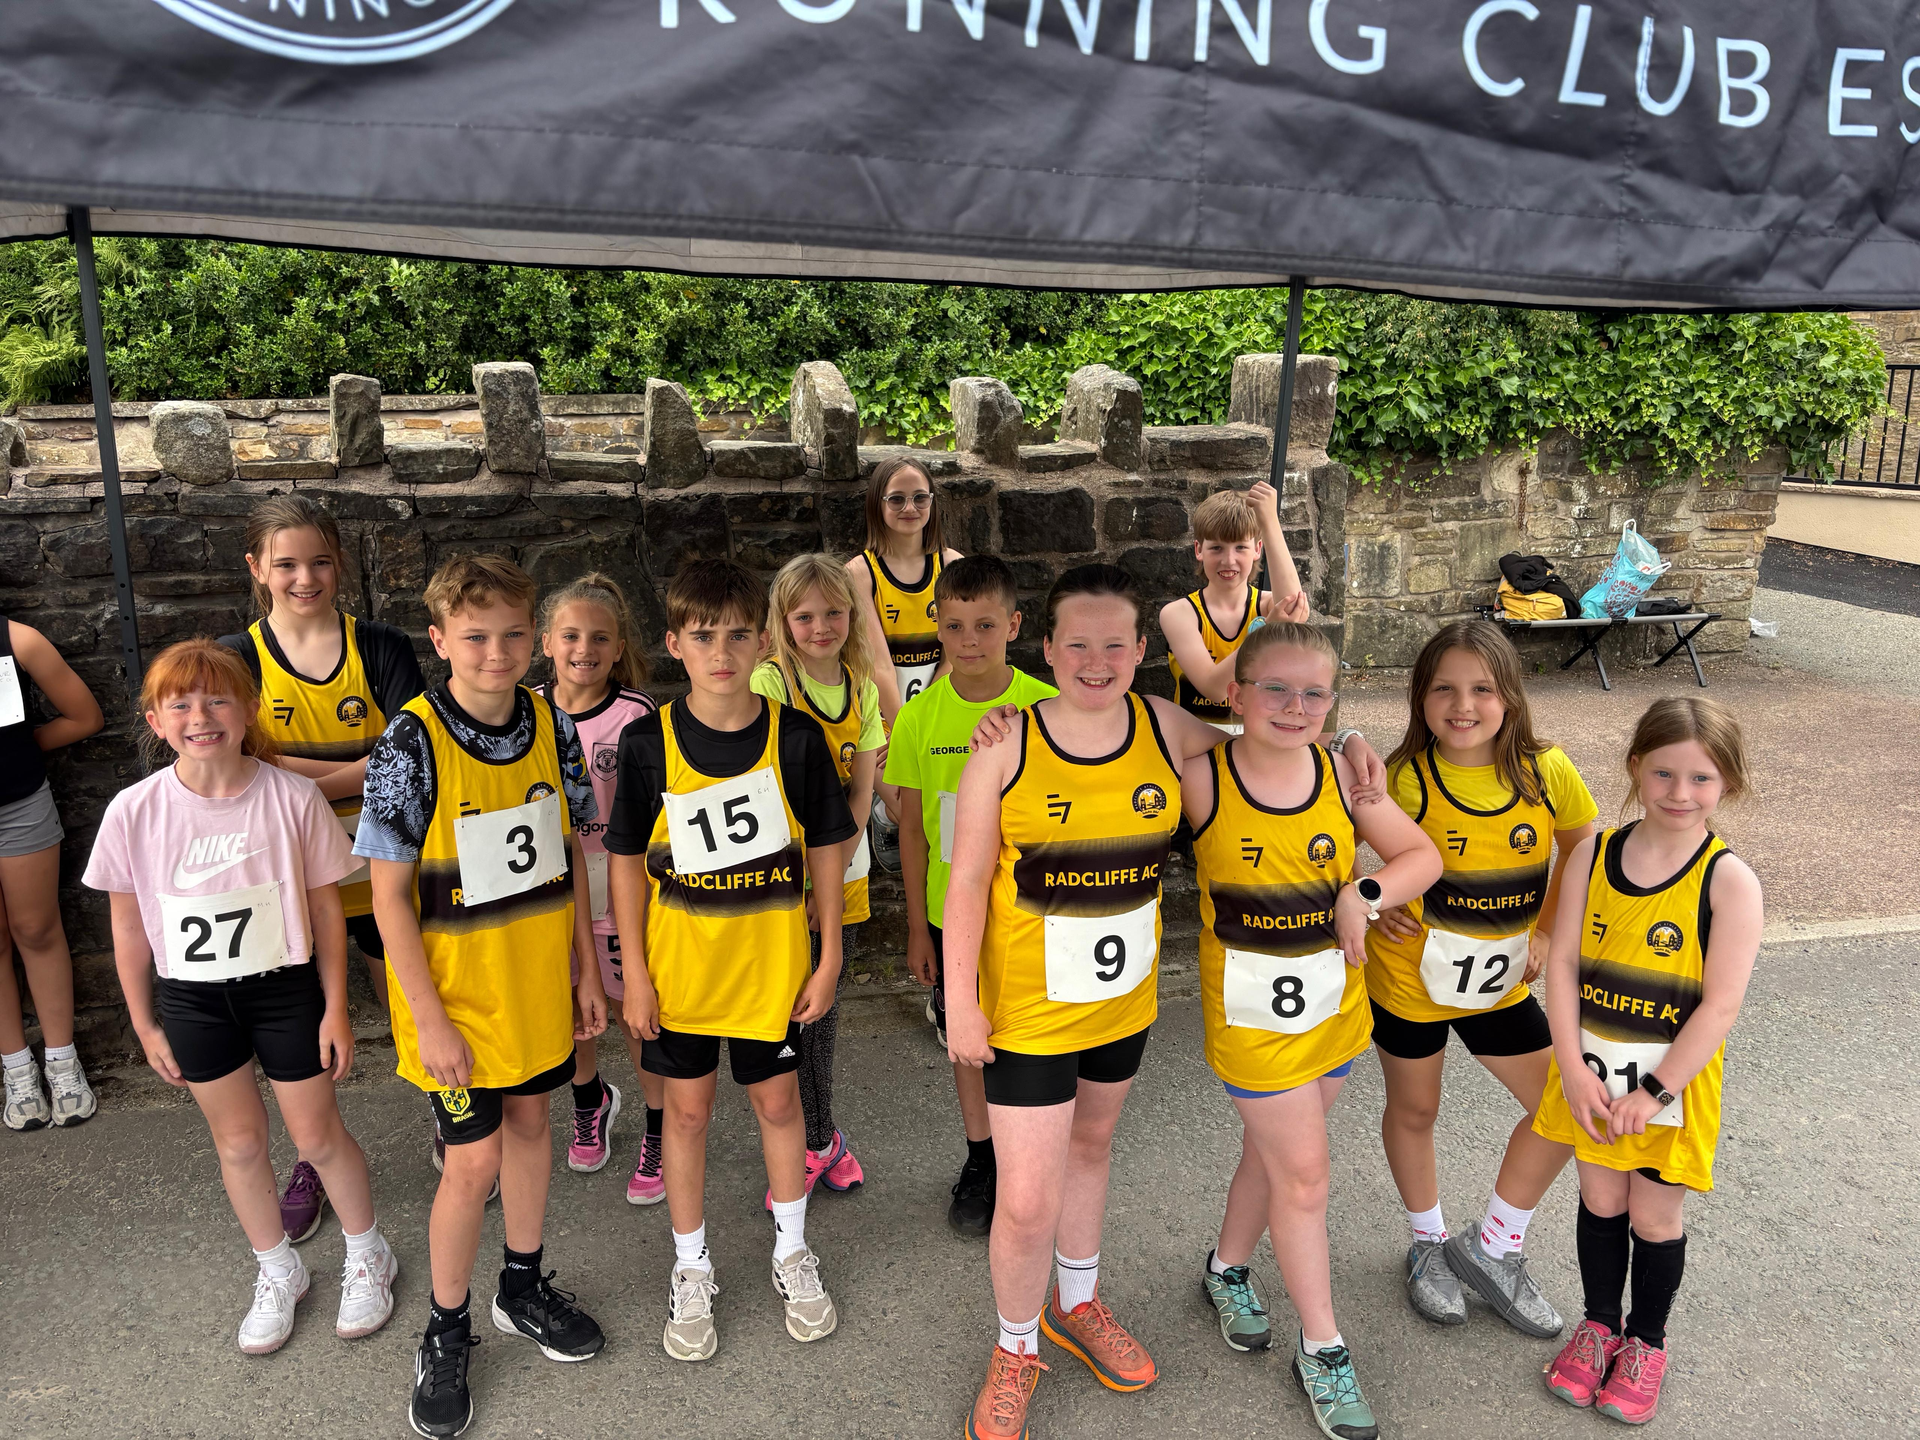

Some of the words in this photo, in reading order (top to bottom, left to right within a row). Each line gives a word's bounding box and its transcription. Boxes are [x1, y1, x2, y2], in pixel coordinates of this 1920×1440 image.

[660, 0, 1387, 74] NING
[1462, 0, 1771, 128] CLUB
[891, 651, 931, 663] ADCLIFFE
[905, 678, 922, 703] 6
[930, 746, 970, 756] GEORGE
[686, 794, 759, 853] 15
[186, 831, 249, 867] NIKE
[506, 824, 537, 875] 3
[769, 865, 792, 883] AC
[1045, 867, 1139, 888] RADCLIFFE
[1141, 863, 1159, 881] AC
[1242, 911, 1325, 930] RADCLIFFE
[1328, 907, 1335, 922] A
[1447, 894, 1521, 910] RADCLIFFE
[1523, 890, 1536, 905] AC
[180, 907, 253, 962] 27
[1093, 934, 1127, 982] 9
[1452, 953, 1510, 994] 12
[1270, 975, 1306, 1018] 8
[1579, 983, 1656, 1018] ADCLIFFE
[1660, 1003, 1680, 1024] AC
